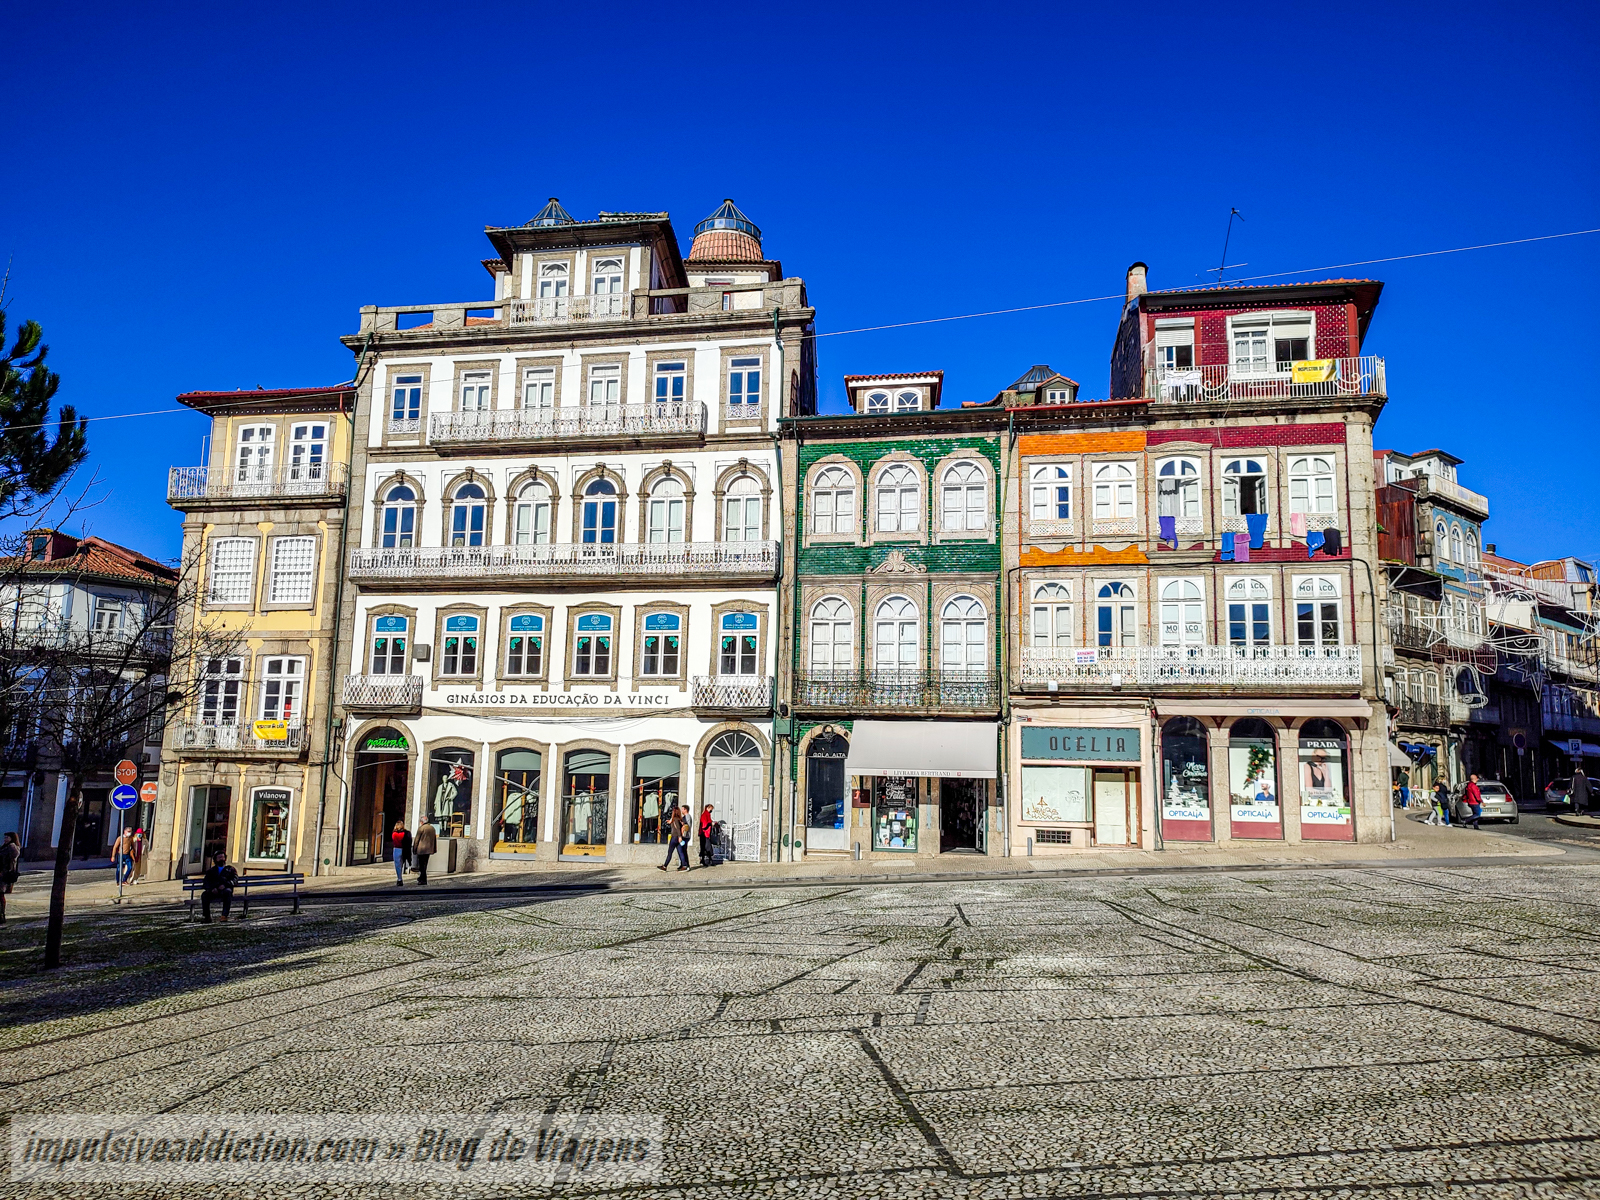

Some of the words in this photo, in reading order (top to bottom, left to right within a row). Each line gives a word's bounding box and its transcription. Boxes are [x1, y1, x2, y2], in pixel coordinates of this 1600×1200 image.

[1300, 584, 1333, 592] MOACO
[447, 692, 506, 705] GINÁSIOS
[510, 694, 527, 704] DA
[532, 693, 599, 707] EDUCAÇÃO
[603, 695, 622, 705] DA
[628, 695, 670, 705] VINCI
[259, 791, 287, 799] Vilanova
